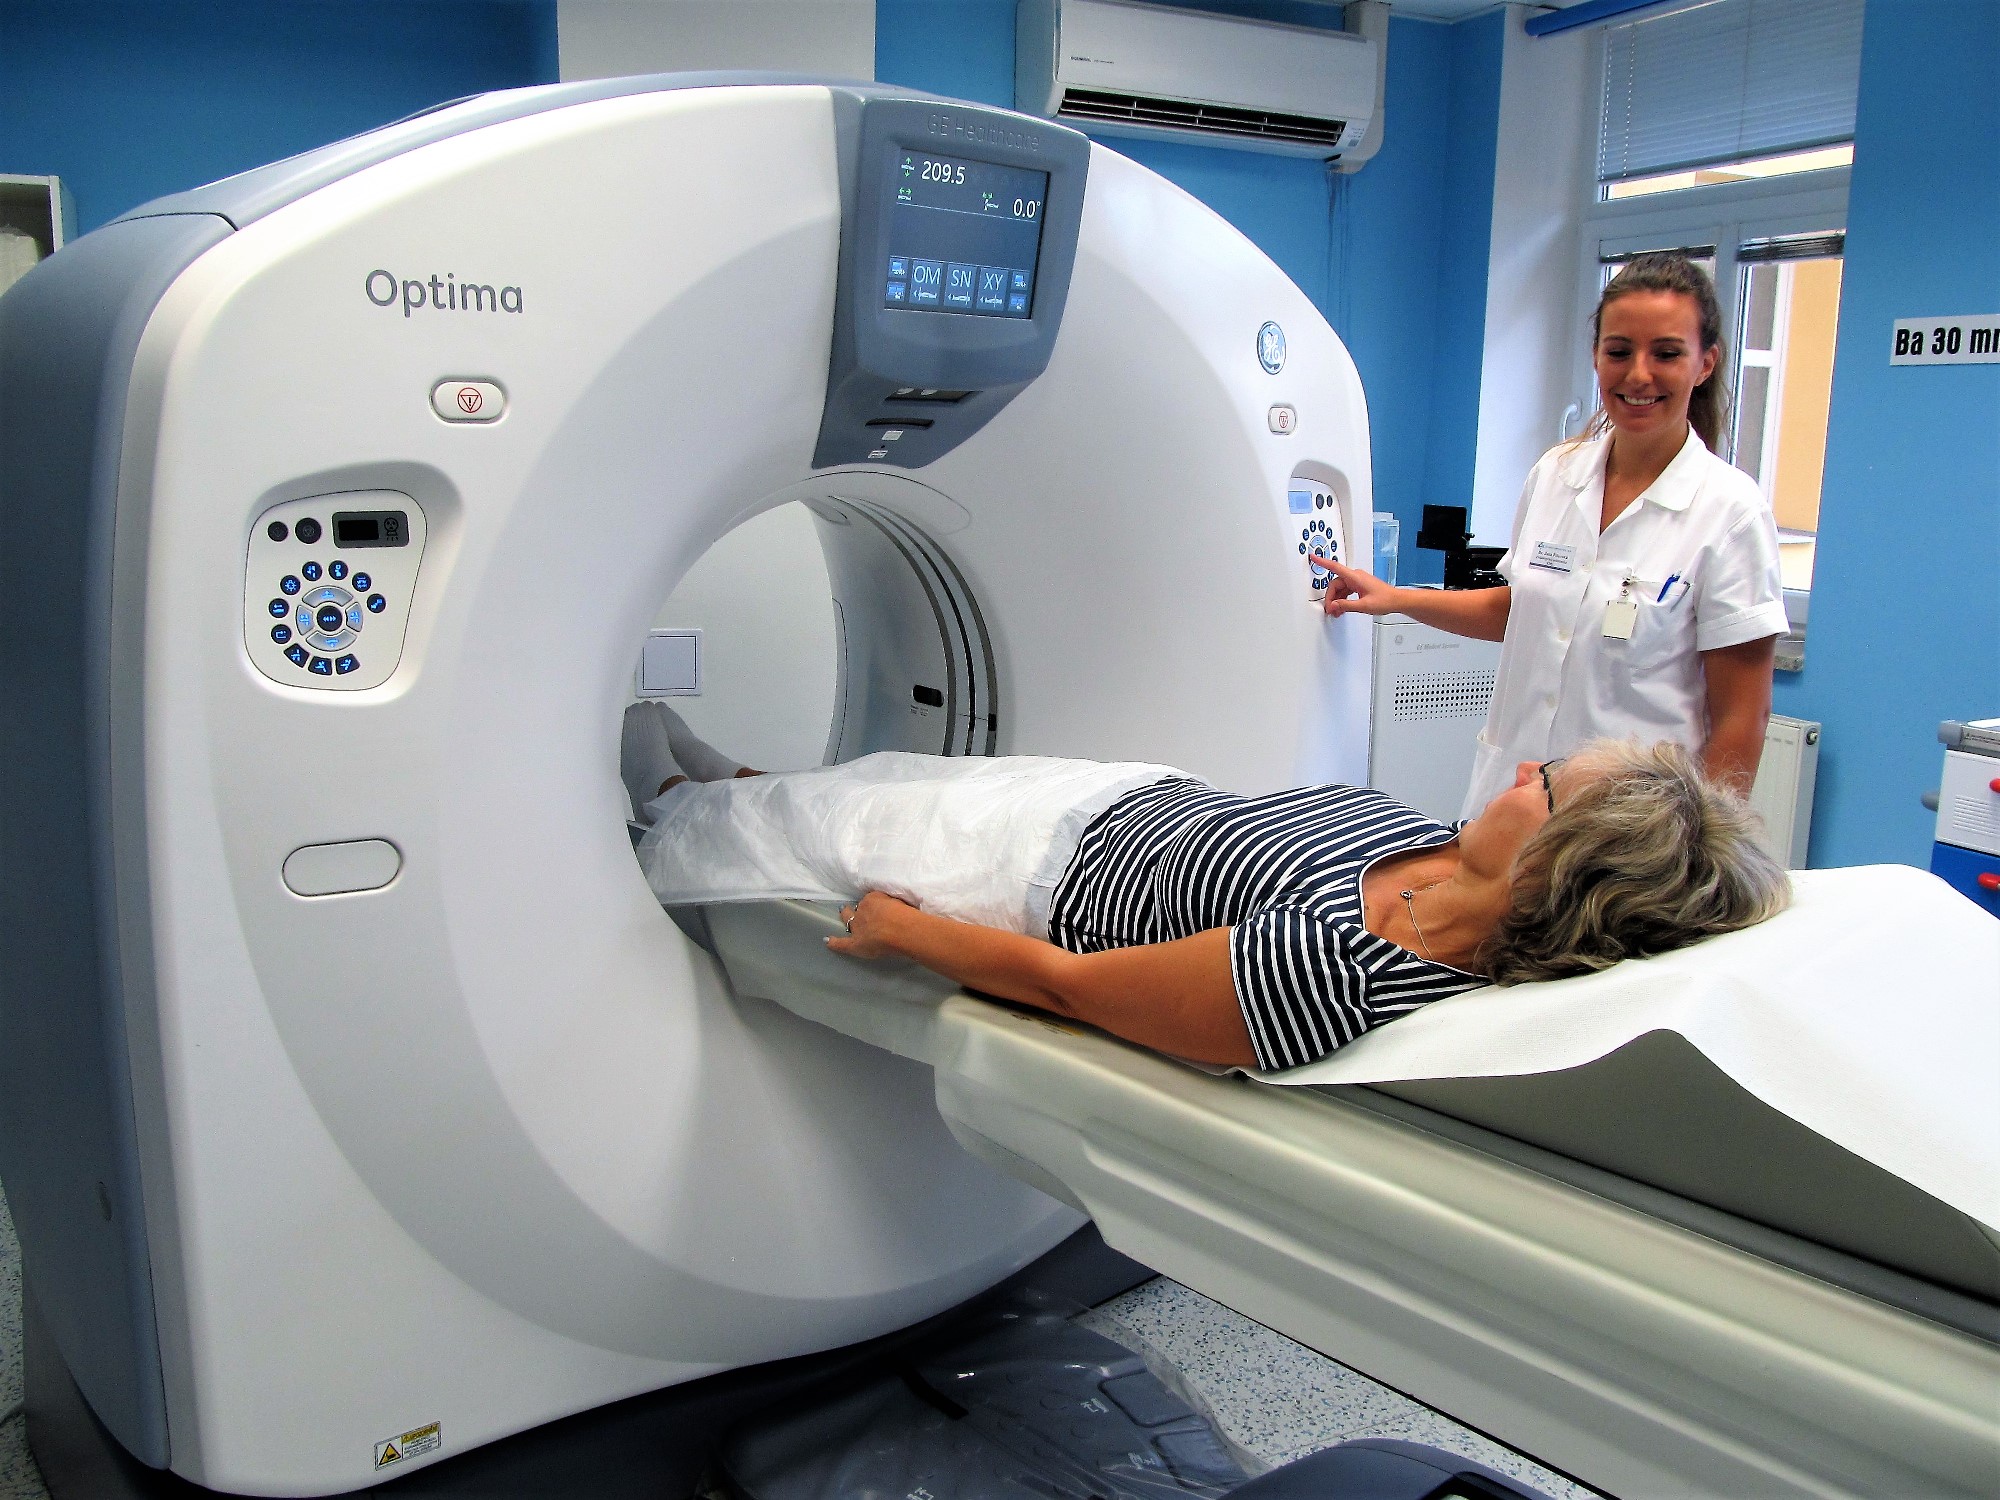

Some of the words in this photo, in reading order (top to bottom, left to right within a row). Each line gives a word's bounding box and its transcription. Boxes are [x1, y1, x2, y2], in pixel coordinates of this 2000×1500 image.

[927, 114, 949, 136] GE
[954, 118, 1040, 152] Healthcare
[921, 160, 966, 185] 209.5
[913, 265, 941, 285] OM
[950, 269, 972, 288] SN
[983, 272, 1004, 291] XY
[365, 269, 524, 319] Optima
[1895, 328, 1924, 356] Ba
[1931, 326, 1962, 355] 30
